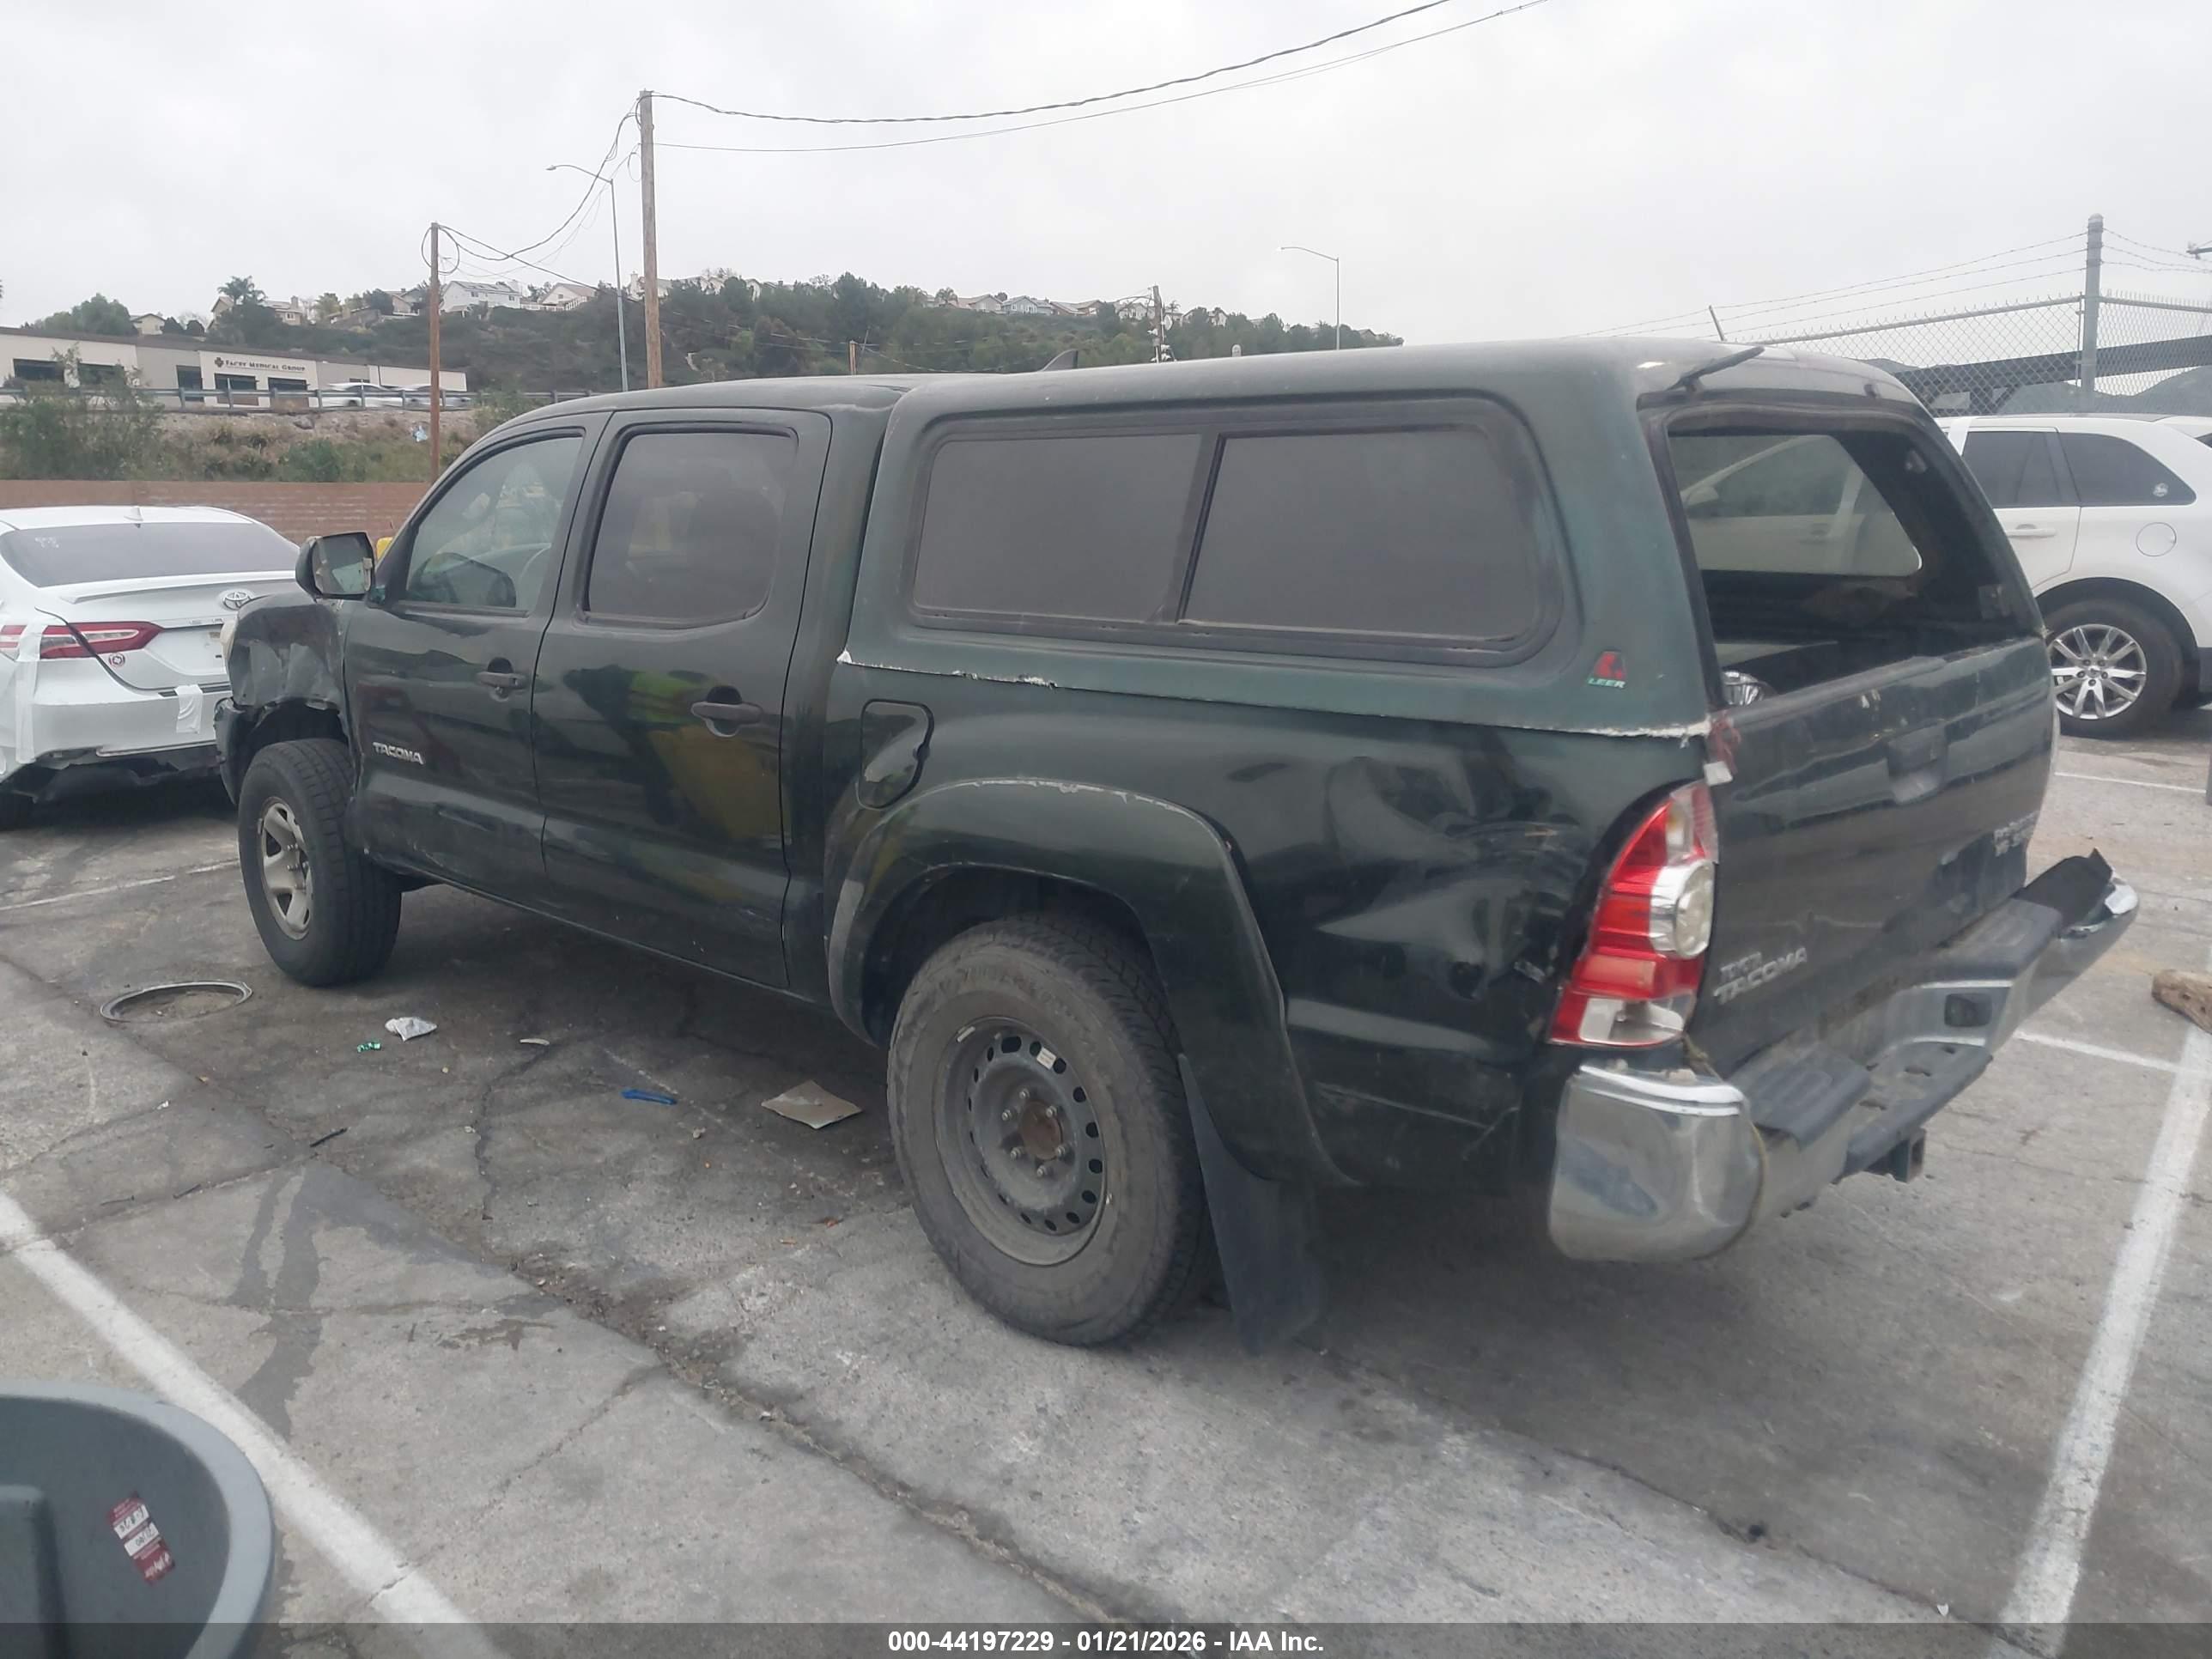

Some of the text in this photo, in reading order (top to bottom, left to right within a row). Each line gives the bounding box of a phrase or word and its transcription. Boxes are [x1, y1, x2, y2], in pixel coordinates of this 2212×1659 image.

[1587, 678, 1626, 689] LEER
[372, 741, 424, 765] TACOMA
[1712, 947, 1808, 1006] TACOMA
